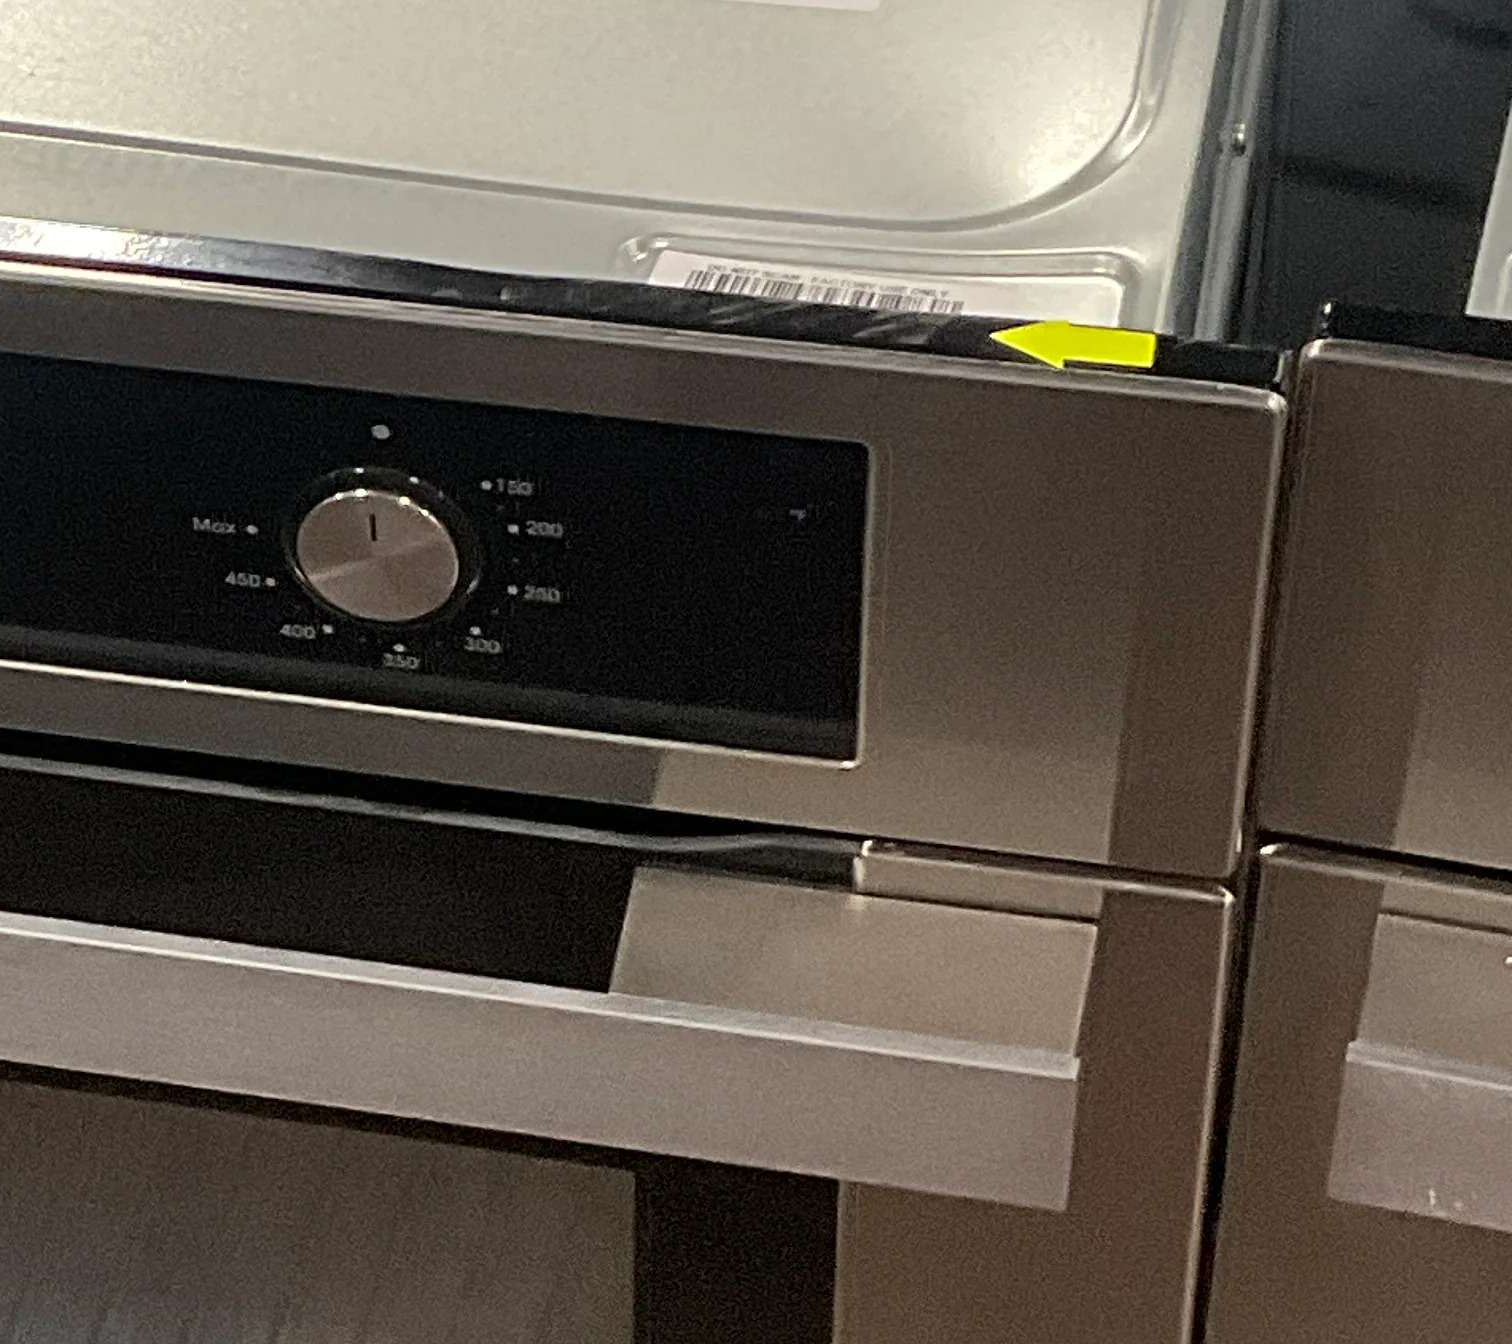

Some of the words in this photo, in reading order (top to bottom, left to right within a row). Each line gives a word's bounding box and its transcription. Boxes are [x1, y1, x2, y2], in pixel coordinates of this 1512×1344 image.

[496, 477, 534, 496] 150
[192, 516, 237, 534] Max
[525, 520, 564, 538] 200
[225, 571, 261, 588] 450
[523, 584, 561, 603] 250
[279, 623, 316, 640] 400
[464, 636, 503, 654] 300
